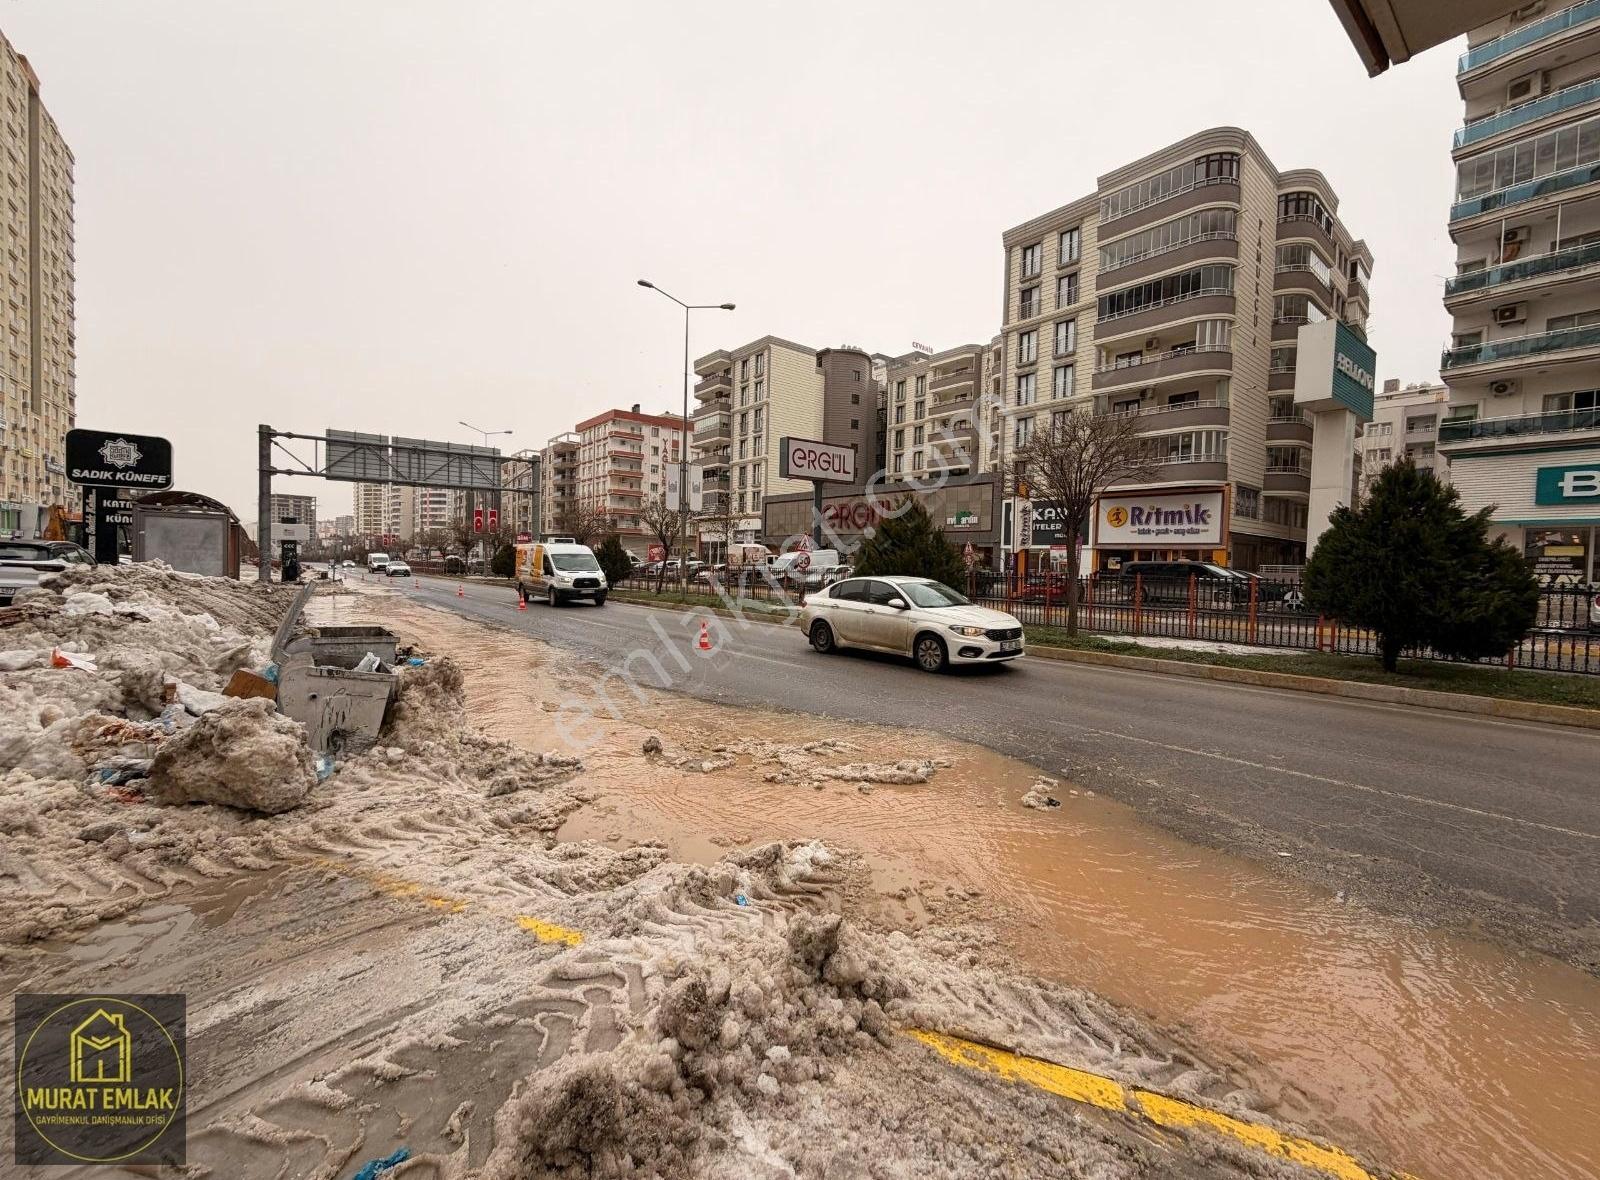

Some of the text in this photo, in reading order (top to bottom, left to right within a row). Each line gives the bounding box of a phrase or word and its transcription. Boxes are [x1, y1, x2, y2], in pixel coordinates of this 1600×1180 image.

[71, 468, 114, 480] SADIK
[115, 471, 167, 484] KÜNEFE
[1130, 504, 1210, 526] Ritmik
